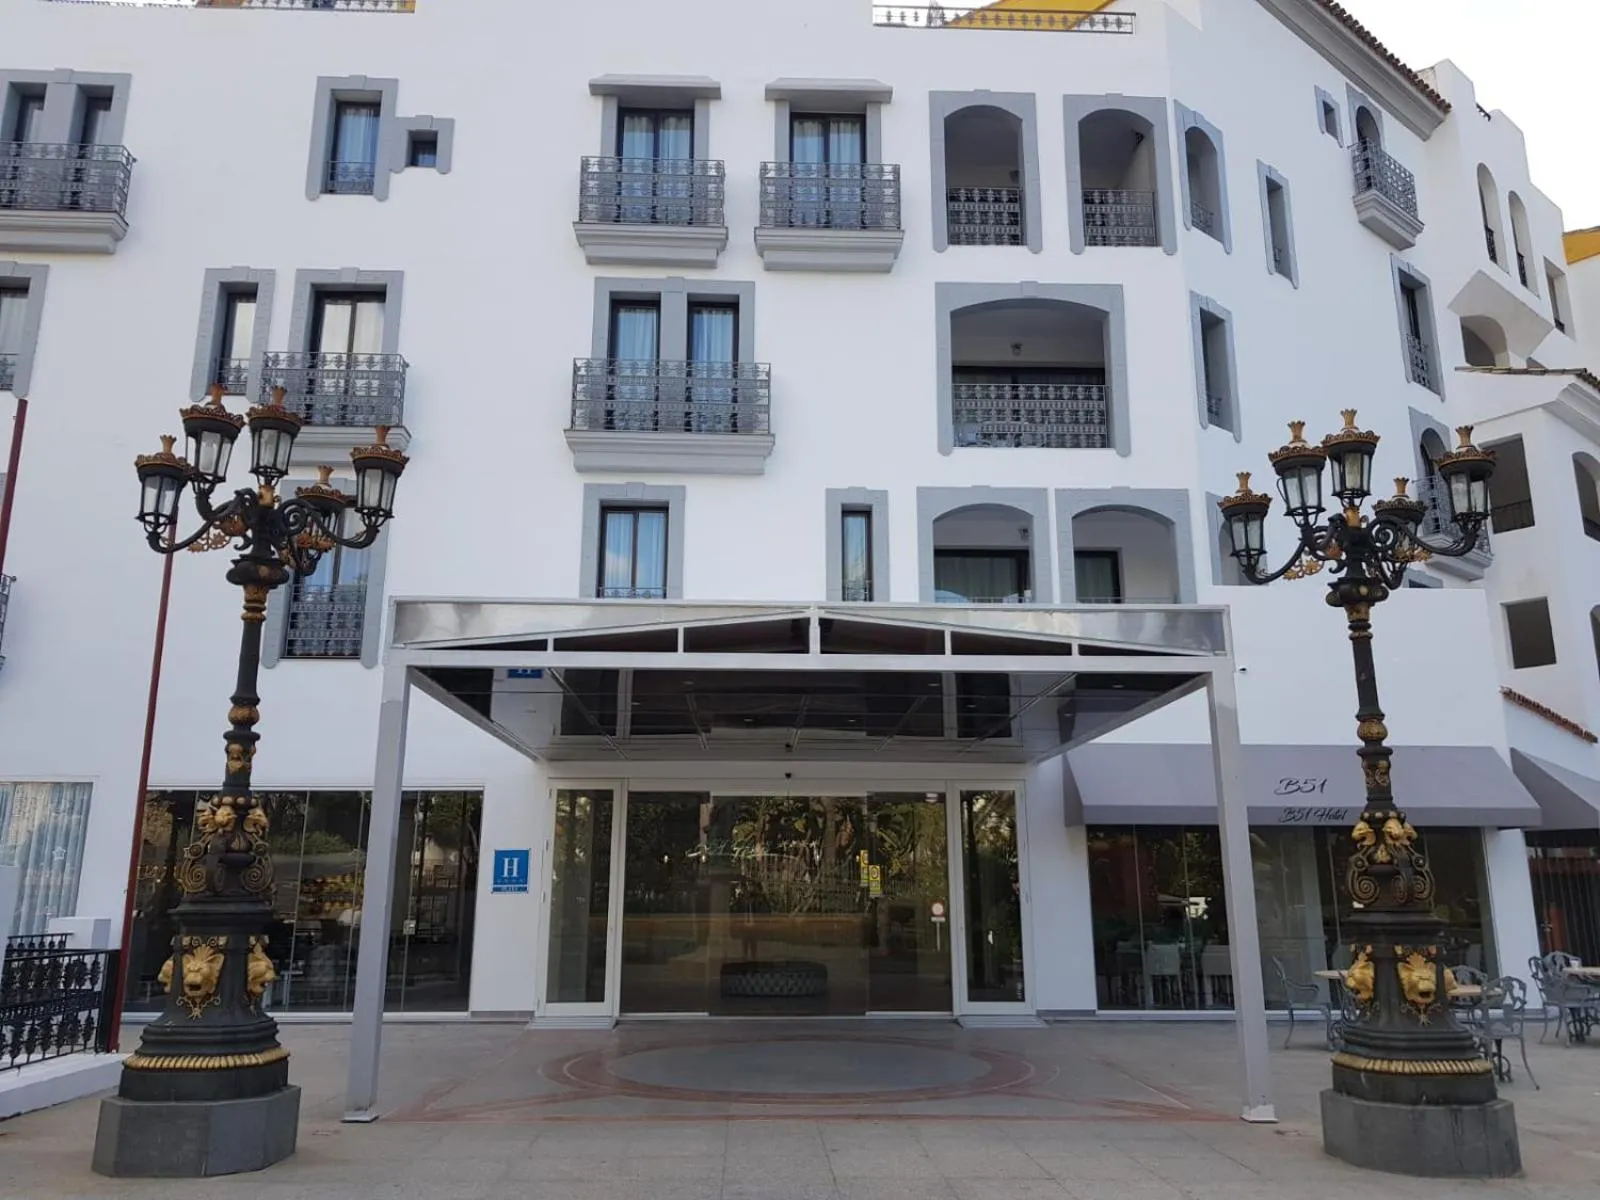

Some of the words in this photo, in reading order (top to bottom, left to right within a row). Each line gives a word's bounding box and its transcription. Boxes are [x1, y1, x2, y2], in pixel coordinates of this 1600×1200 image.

[1274, 777, 1327, 795] B51
[1279, 807, 1312, 823] B51
[1313, 807, 1349, 822] Hotel
[502, 857, 520, 877] H
